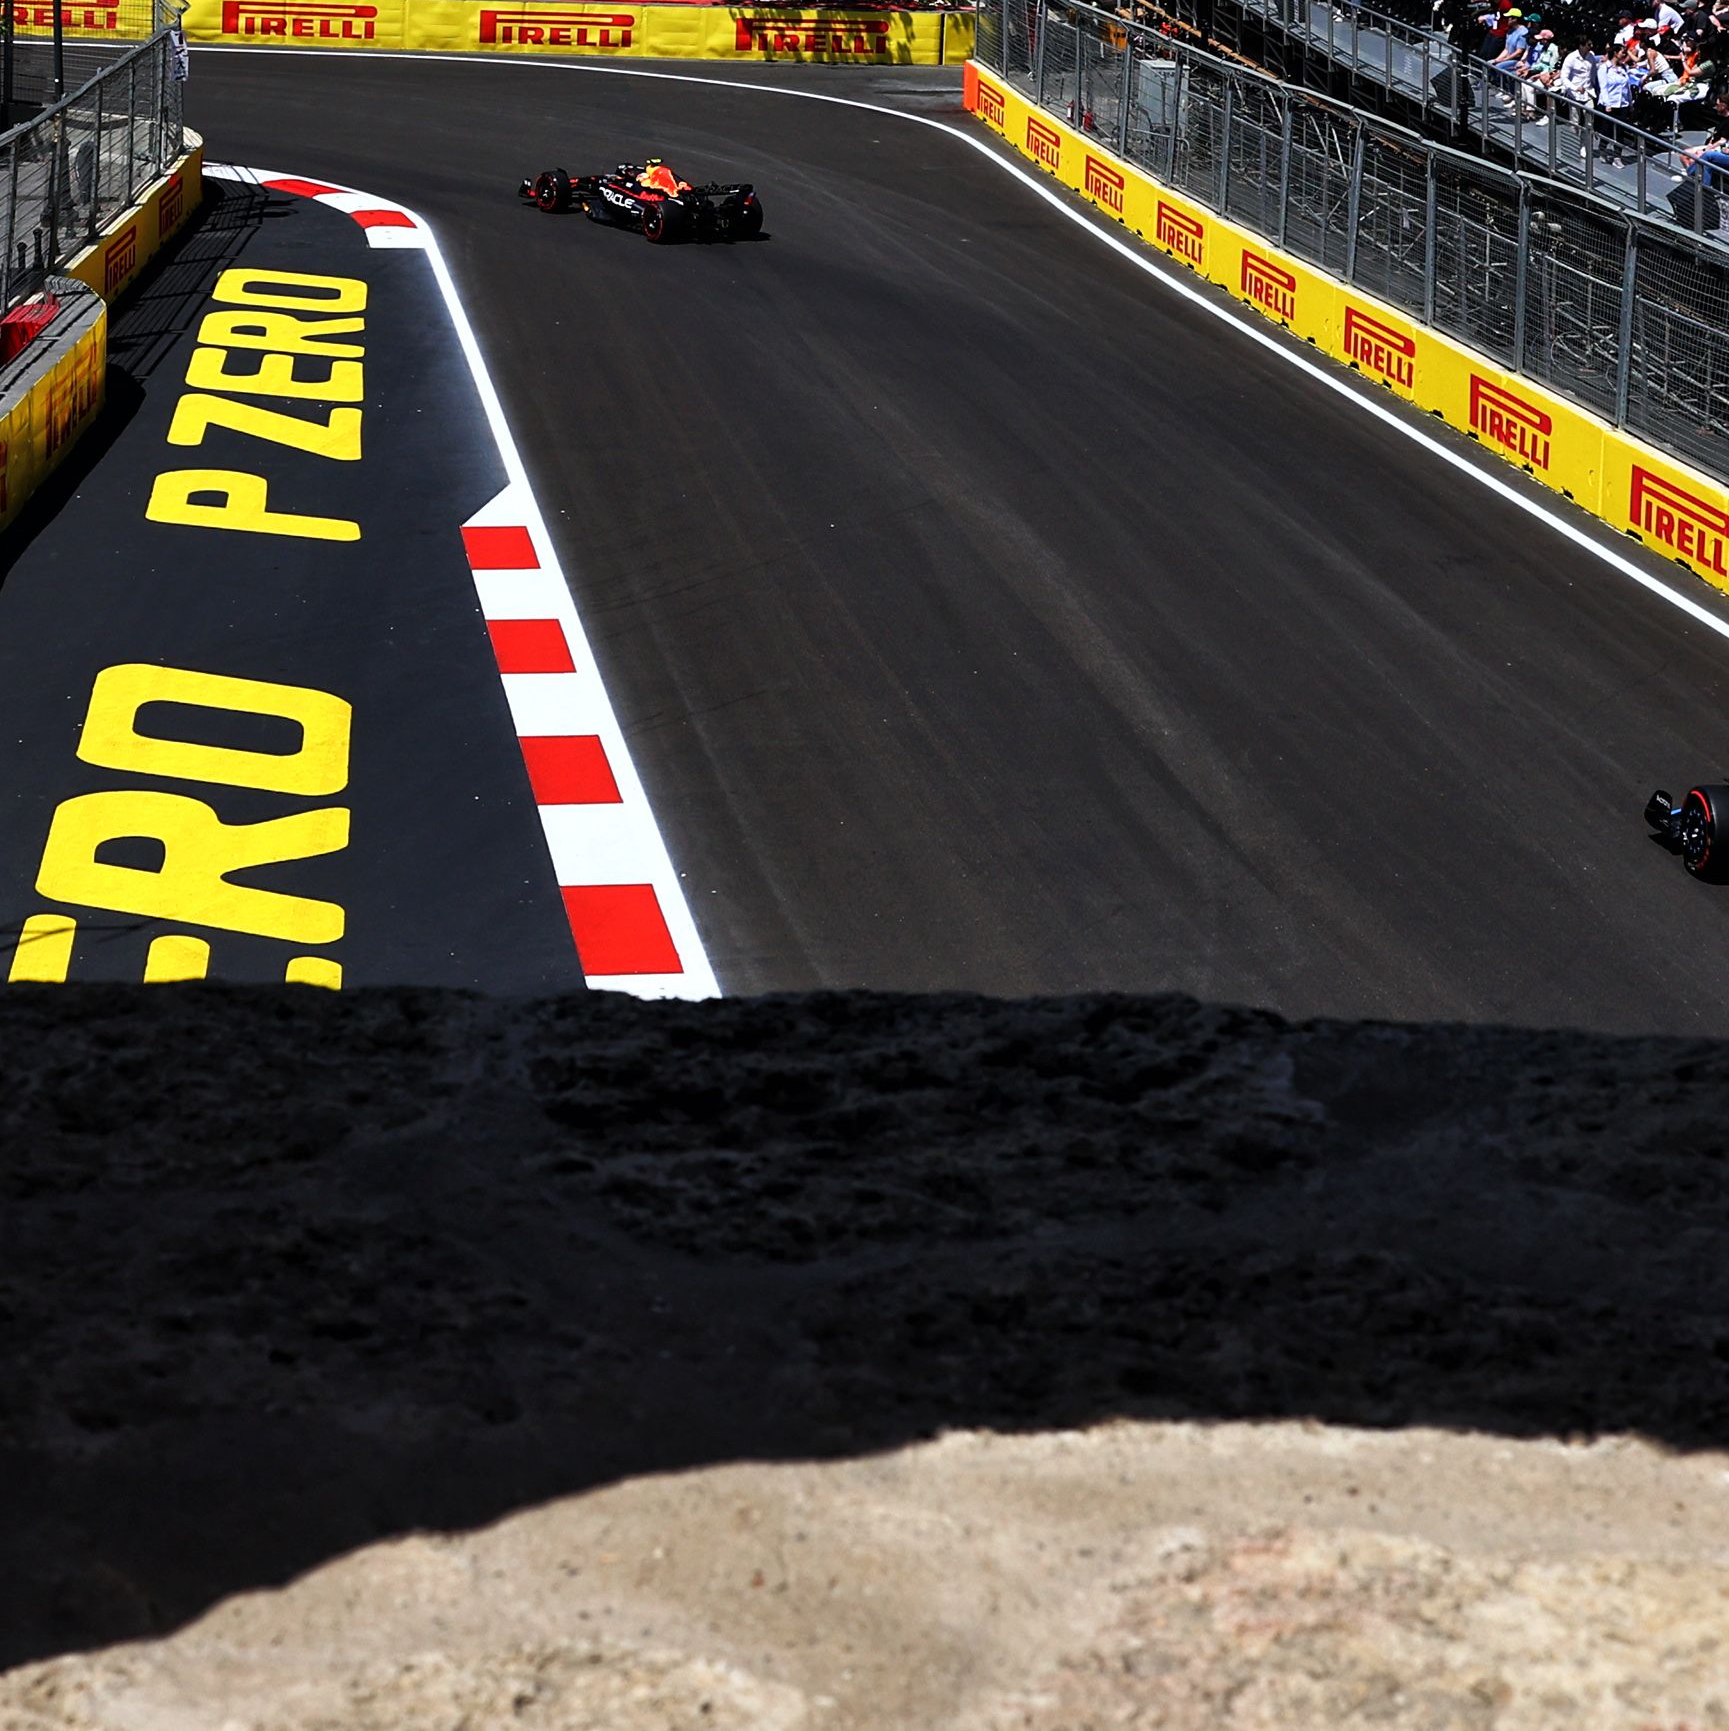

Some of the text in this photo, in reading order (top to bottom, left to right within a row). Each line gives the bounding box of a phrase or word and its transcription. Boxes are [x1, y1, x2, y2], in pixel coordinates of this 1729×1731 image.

[221, 0, 378, 40] PIRELLI
[479, 9, 635, 49] PIRELLI
[734, 16, 890, 55] PIRELLI
[977, 79, 1005, 128] PIRELLI
[1026, 116, 1061, 171] PIRELLI
[1084, 155, 1124, 214] PIRELLI
[104, 224, 137, 296] PIRELLI
[1157, 200, 1204, 266] PIRELLI
[1241, 250, 1296, 321] PIRELLI
[1344, 306, 1416, 388] PIRELLI
[145, 267, 368, 541] P ZERO
[1470, 373, 1552, 470] PIRELLI
